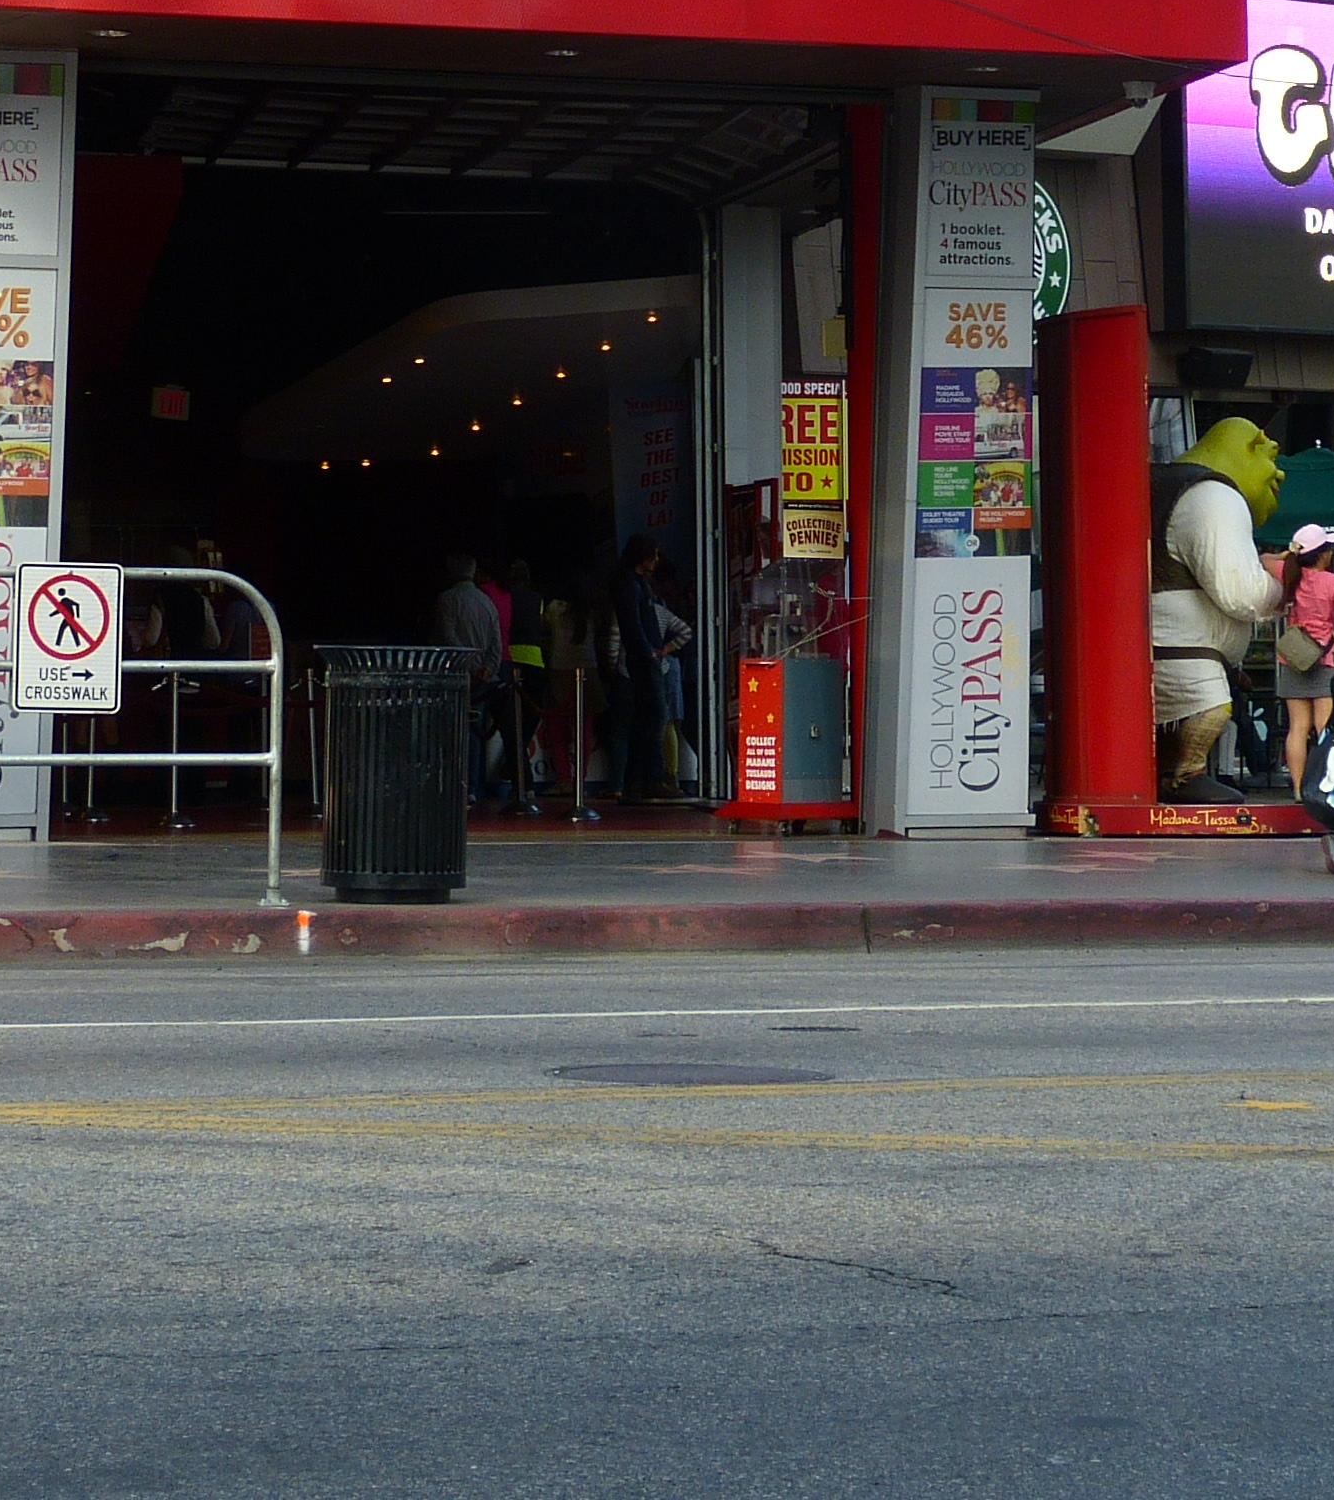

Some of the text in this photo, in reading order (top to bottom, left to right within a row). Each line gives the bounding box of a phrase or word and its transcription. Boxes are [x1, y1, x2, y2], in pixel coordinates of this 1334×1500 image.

[936, 130, 1026, 147] BUY HERE
[932, 160, 1027, 177] HOLLYWOOD
[929, 179, 1027, 212] CityPASS
[939, 222, 1005, 236] 1 booklet.
[939, 238, 1002, 251] 4 famous
[939, 254, 1015, 266] attractions.
[948, 302, 1007, 323] SAVE
[945, 324, 1009, 350] 46%
[782, 404, 840, 445] REE
[643, 427, 674, 447] SEE
[644, 447, 675, 467] THE
[640, 467, 681, 489] BEST
[650, 489, 669, 507] OF
[786, 518, 842, 534] COLLECTIBLE
[789, 529, 839, 548] PENNIES
[39, 667, 68, 681] USE
[25, 685, 108, 701] CROSSWALK
[928, 593, 957, 790] HOLLYWOOD
[957, 588, 1011, 793] CityPASS
[746, 736, 776, 746] COLLECT
[1149, 807, 1259, 833] Madame Tussas
